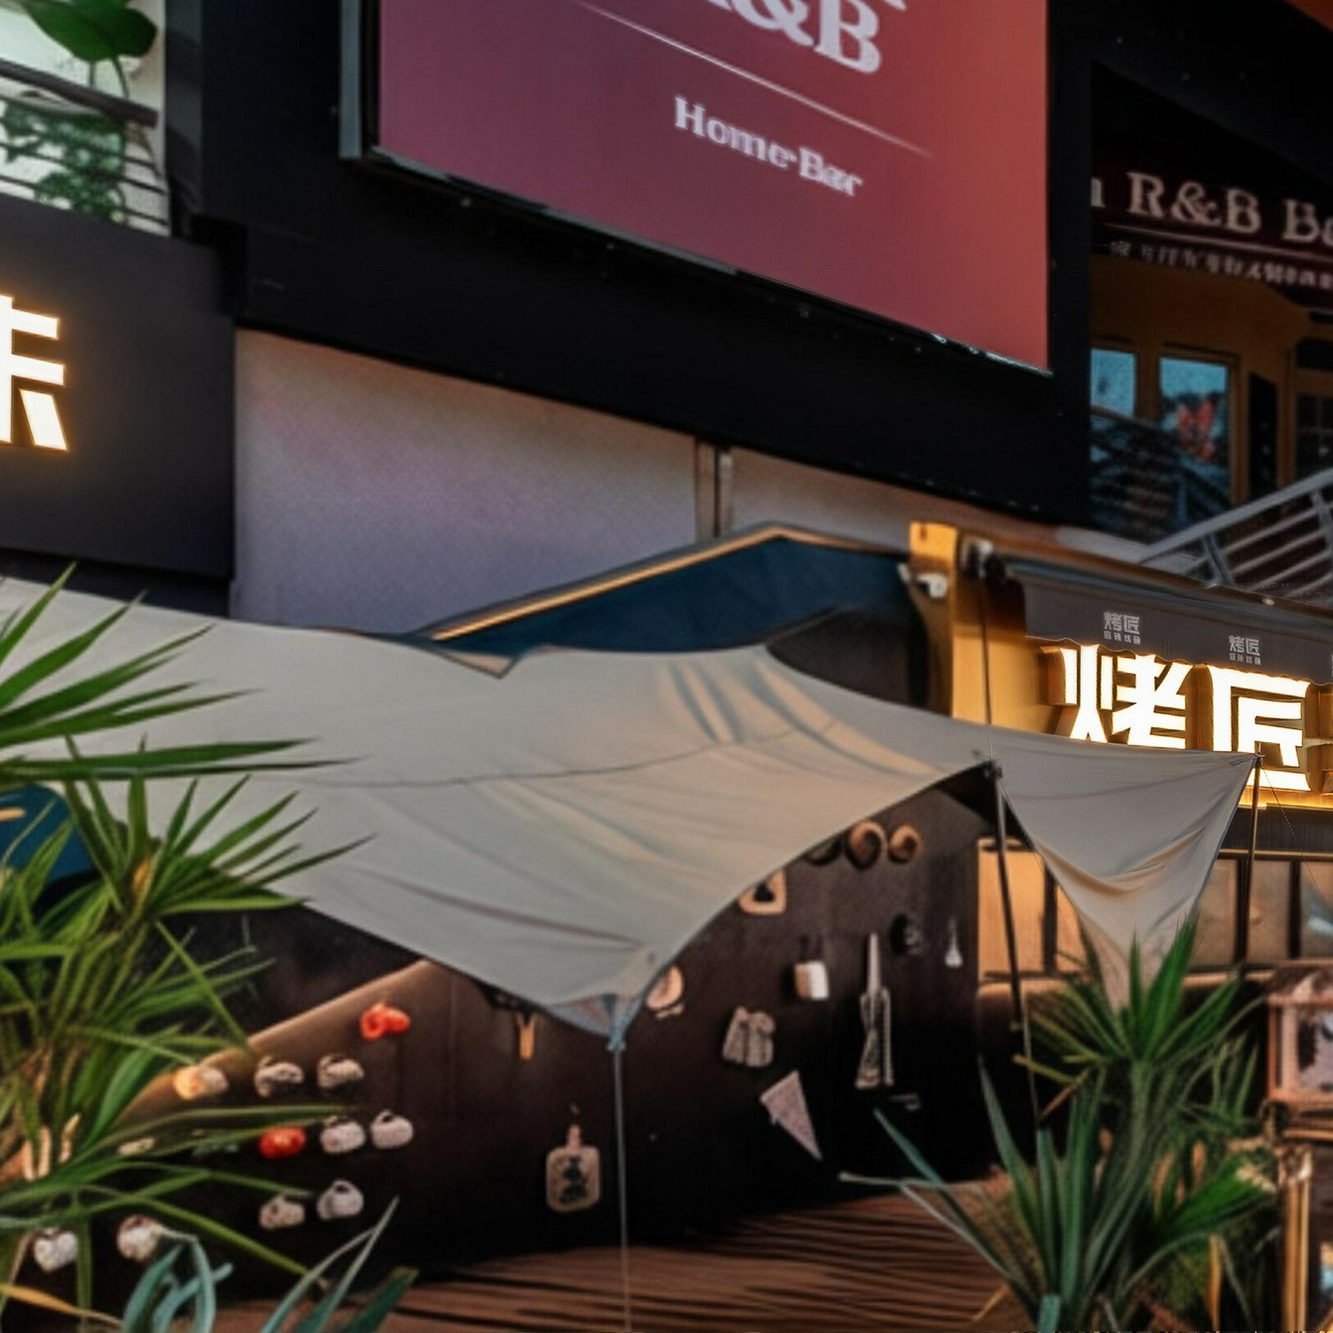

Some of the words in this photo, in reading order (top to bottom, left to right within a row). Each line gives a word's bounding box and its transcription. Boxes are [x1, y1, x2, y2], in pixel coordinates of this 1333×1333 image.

[1126, 171, 1262, 234] R&B
[1104, 612, 1140, 635] 烤匠
[1060, 643, 1312, 792] 烤匠
